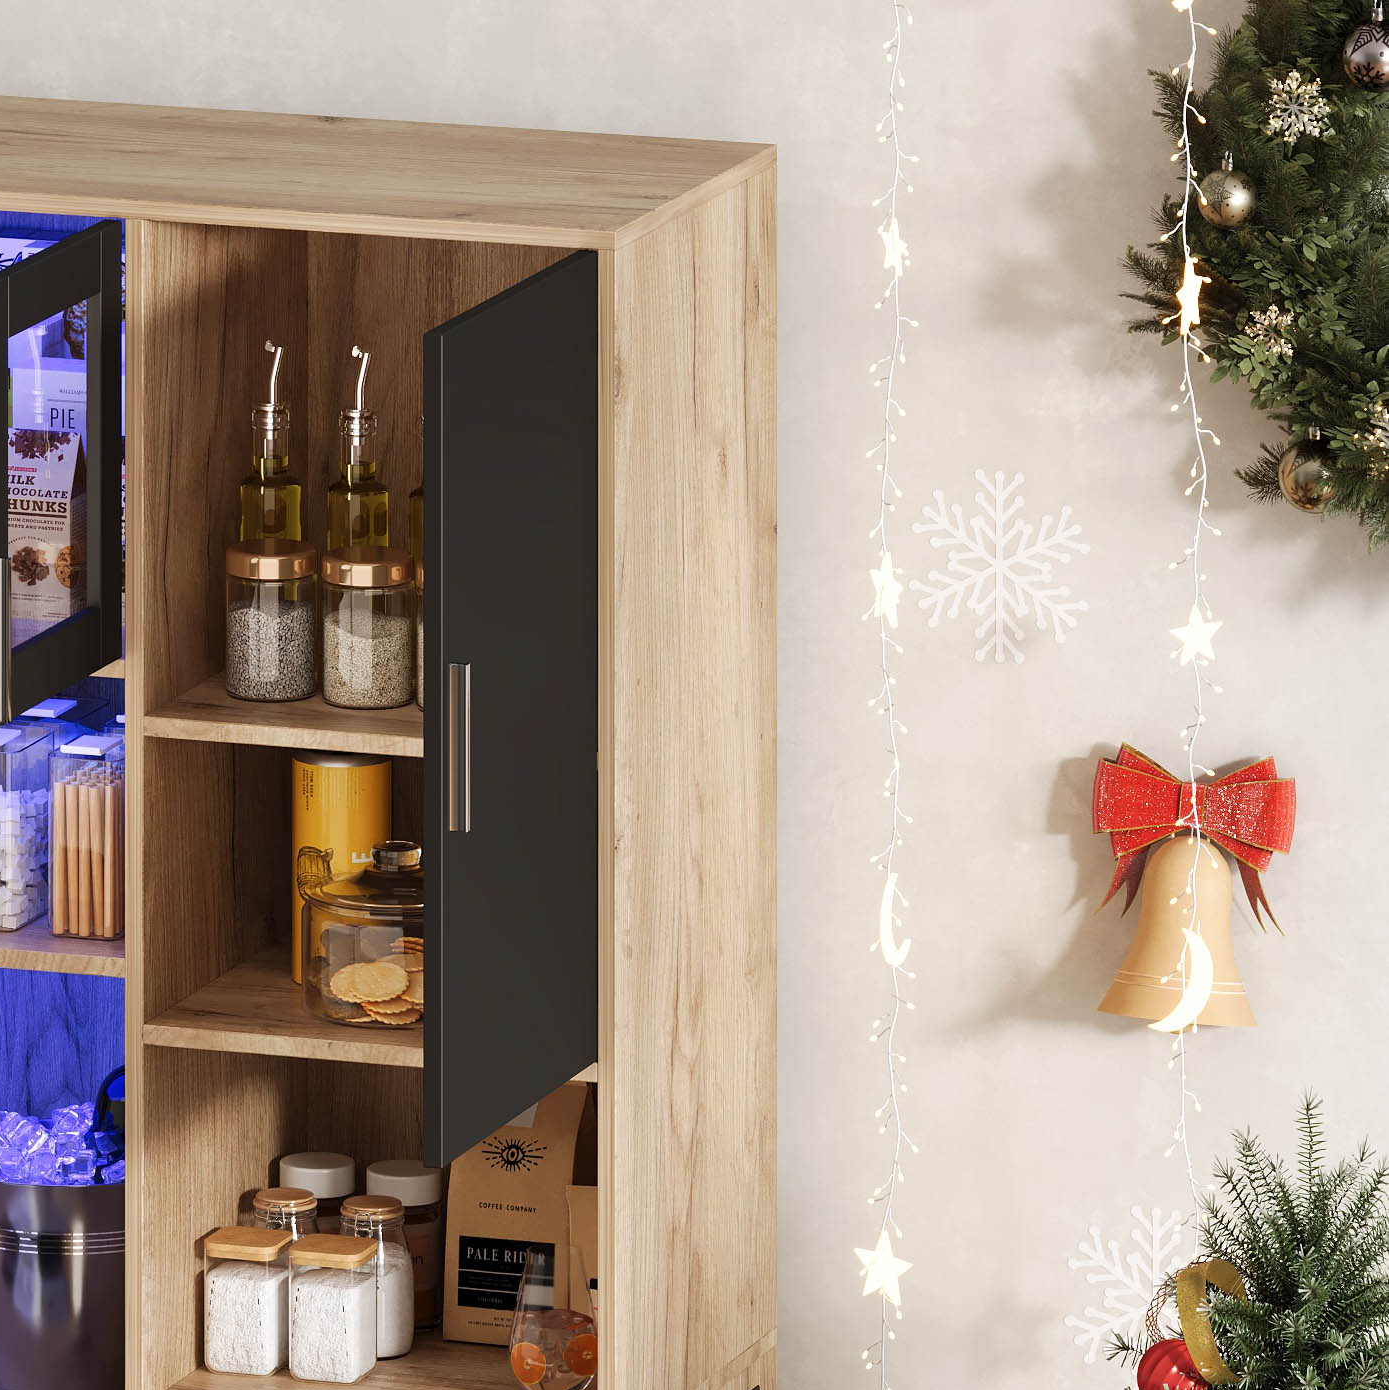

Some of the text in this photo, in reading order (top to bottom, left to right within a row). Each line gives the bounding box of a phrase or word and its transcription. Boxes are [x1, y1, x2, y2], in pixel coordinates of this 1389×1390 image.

[50, 407, 76, 430] PIE
[8, 474, 36, 486] ILK
[8, 487, 69, 499] OCOLATE
[8, 499, 68, 514] HUNKS
[479, 1202, 537, 1214] COFFEE COMPANY
[467, 1246, 500, 1262] PALE
